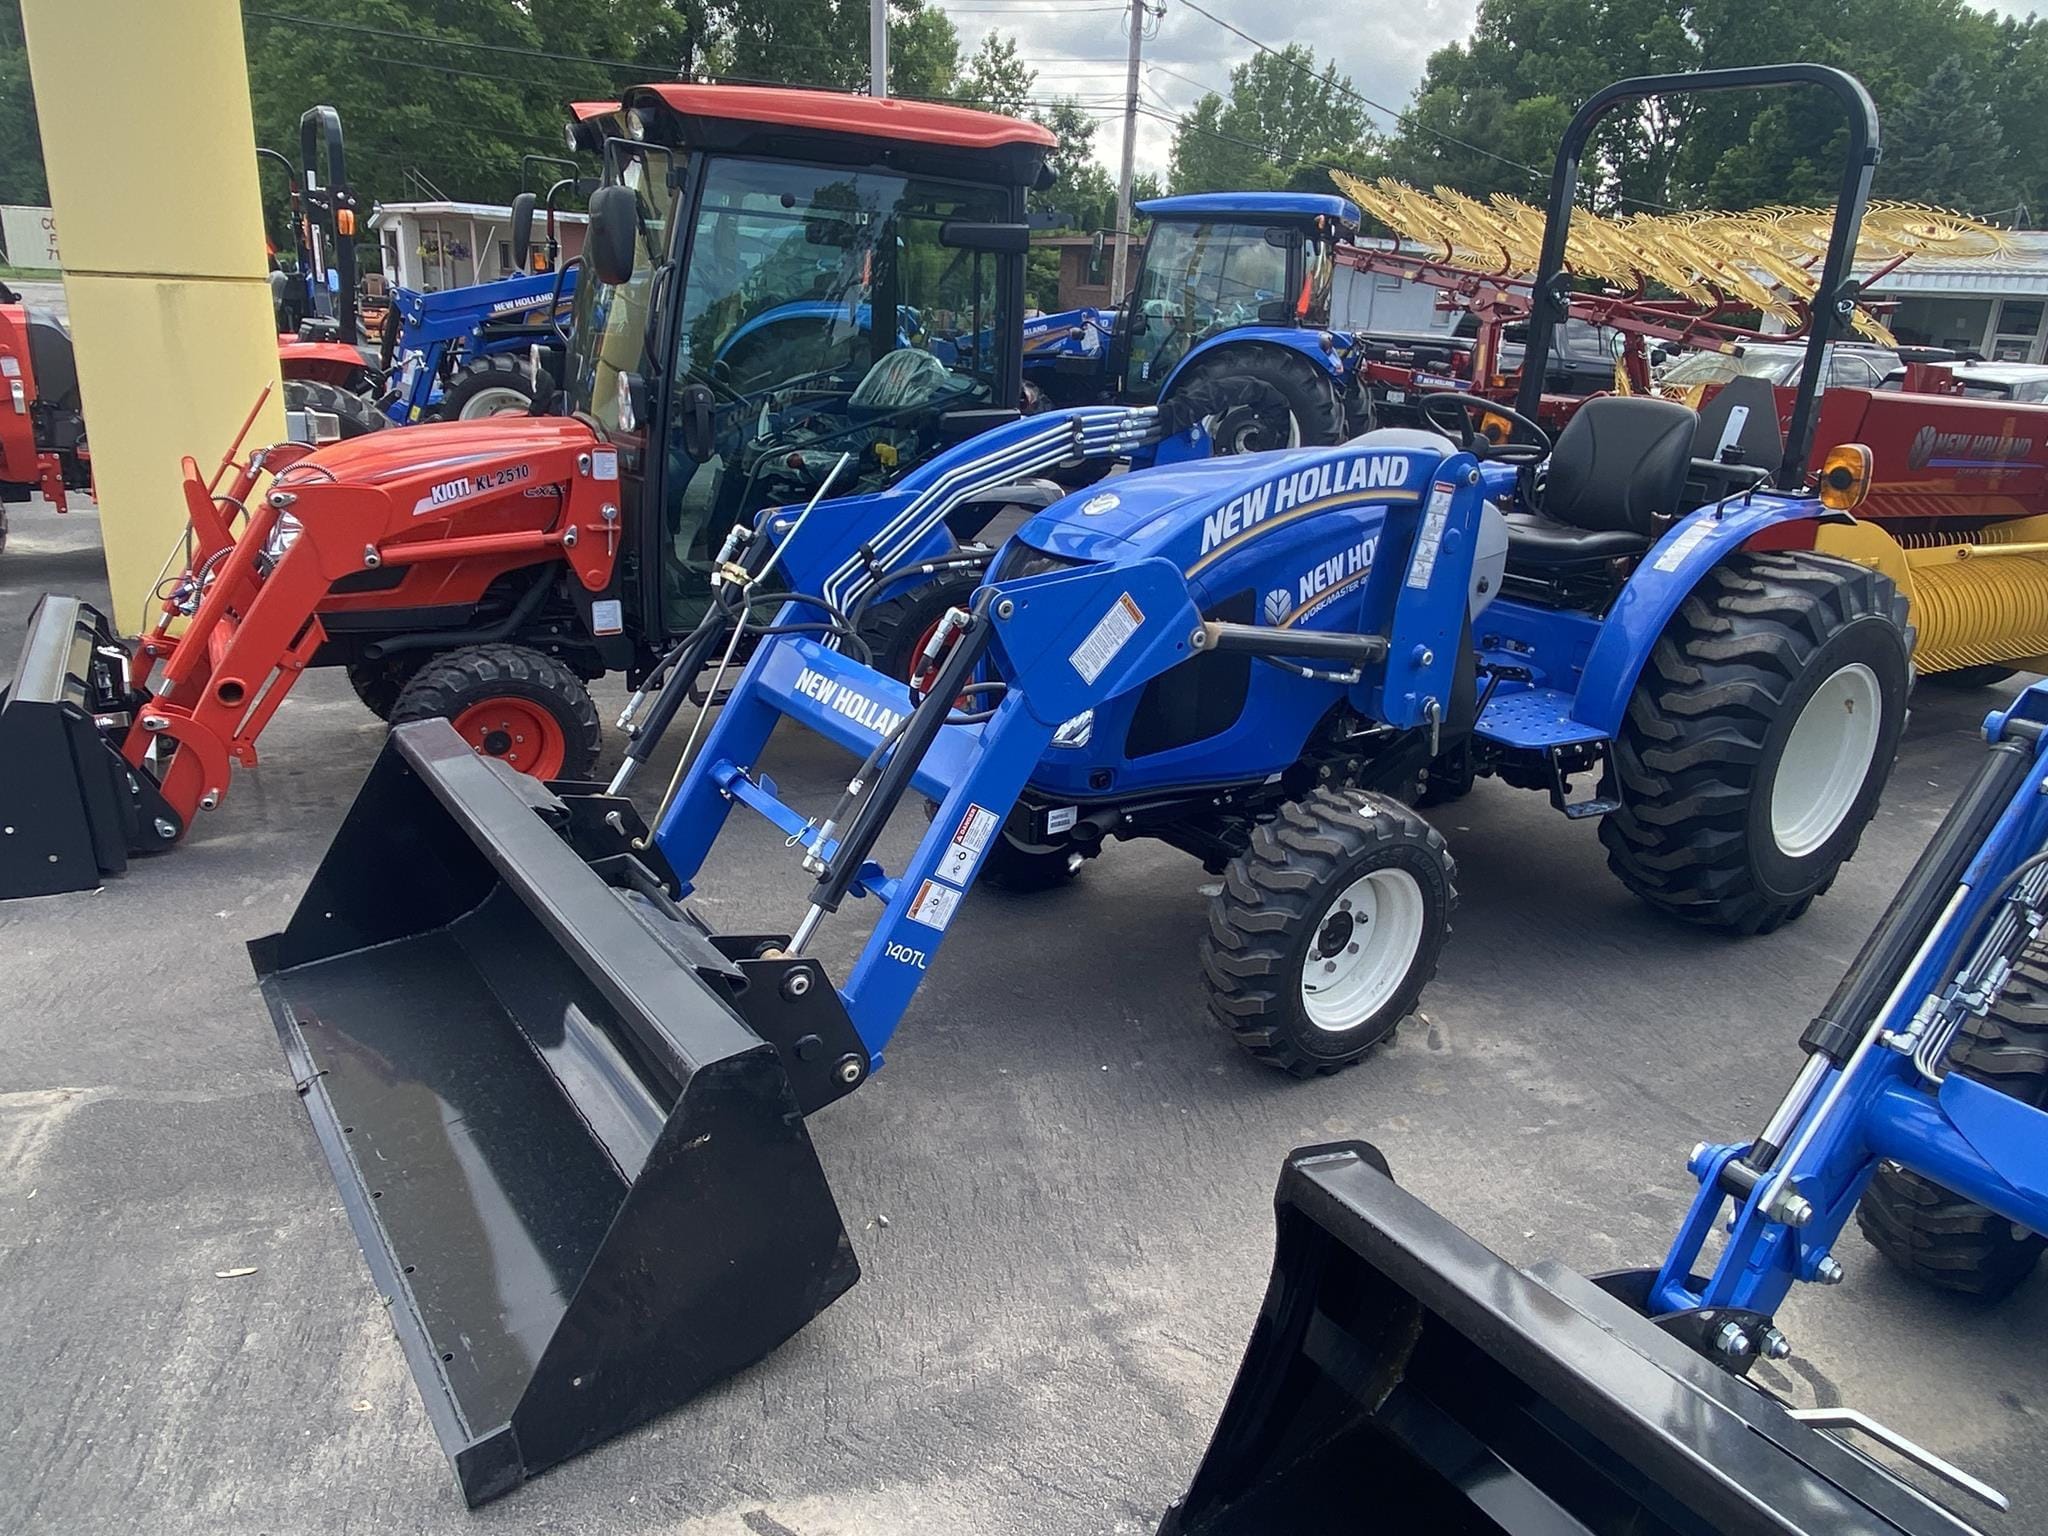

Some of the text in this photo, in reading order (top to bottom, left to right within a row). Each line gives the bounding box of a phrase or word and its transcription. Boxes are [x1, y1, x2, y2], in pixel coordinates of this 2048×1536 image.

[493, 292, 554, 312] NEW HOLLAND
[1935, 433, 2033, 457] NEW HOLLAND
[431, 464, 529, 504] KIOTI KL 2510
[1200, 455, 1410, 556] NEW HOLLAND
[1299, 552, 1345, 605] NEW
[1347, 535, 1380, 575] HO
[1299, 580, 1360, 625] WORKMASTER
[794, 667, 905, 737] NEW HOLLAN
[884, 940, 927, 970] 140TL
